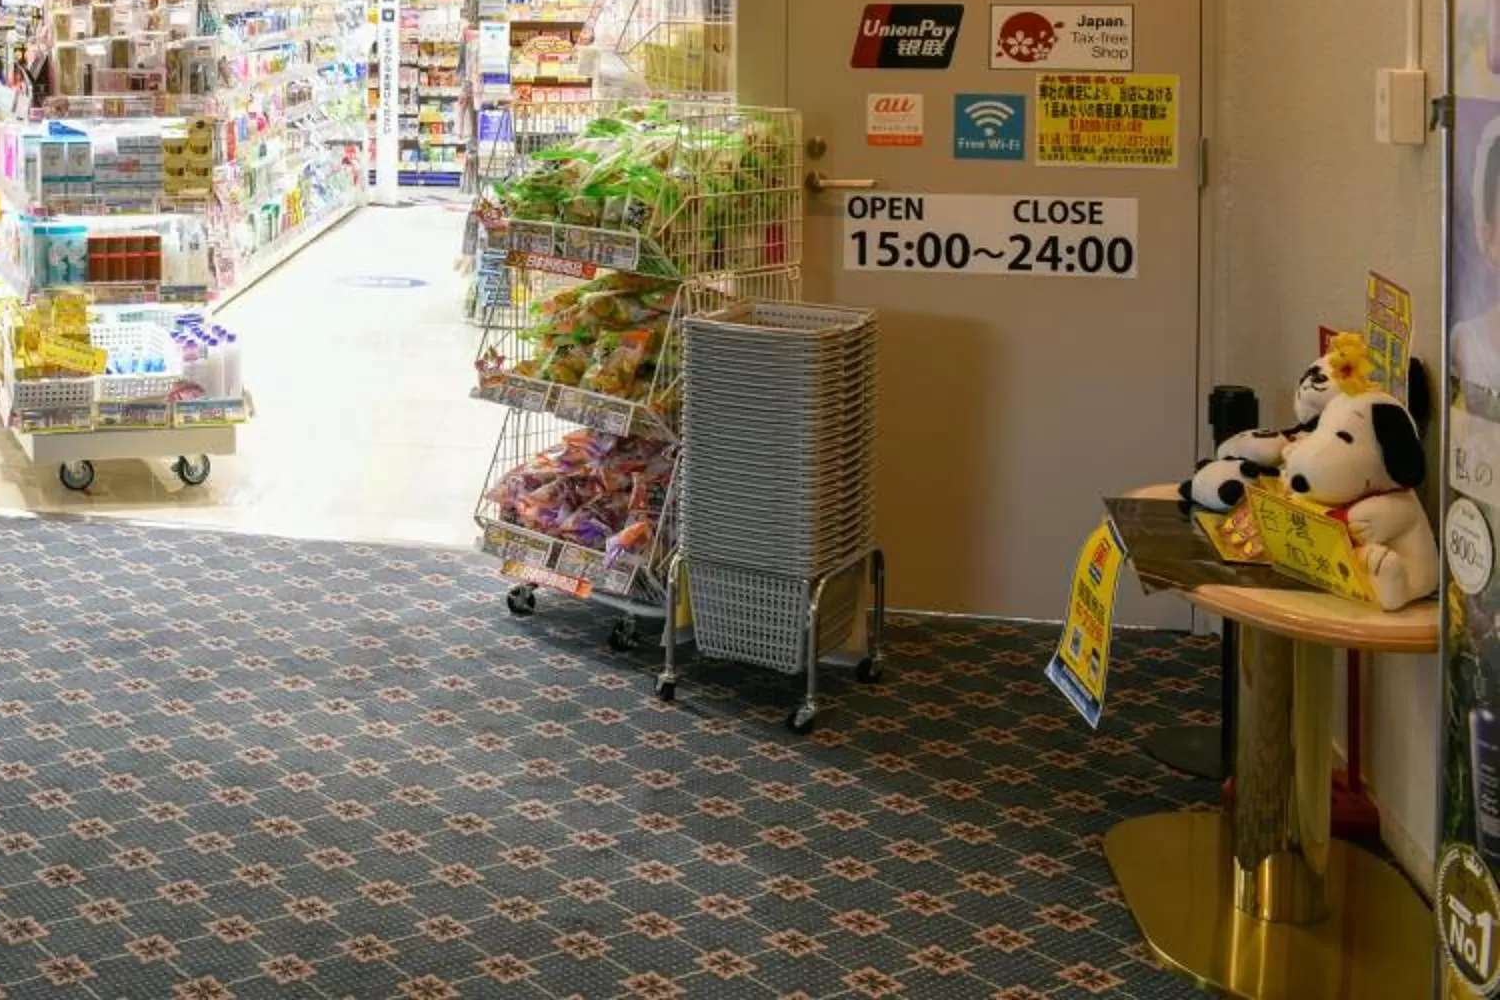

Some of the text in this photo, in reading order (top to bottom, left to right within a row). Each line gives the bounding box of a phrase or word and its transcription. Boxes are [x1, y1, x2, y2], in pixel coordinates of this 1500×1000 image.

[1077, 14, 1125, 31] Japan
[863, 19, 956, 46] UnionPay
[1071, 31, 1129, 45] Tax-free
[1091, 45, 1129, 61] Shop
[874, 97, 915, 113] au
[957, 137, 1021, 151] Free Wi-Fi
[847, 196, 1104, 225] OPEN CLOSE
[1449, 911, 1493, 978] No.1
